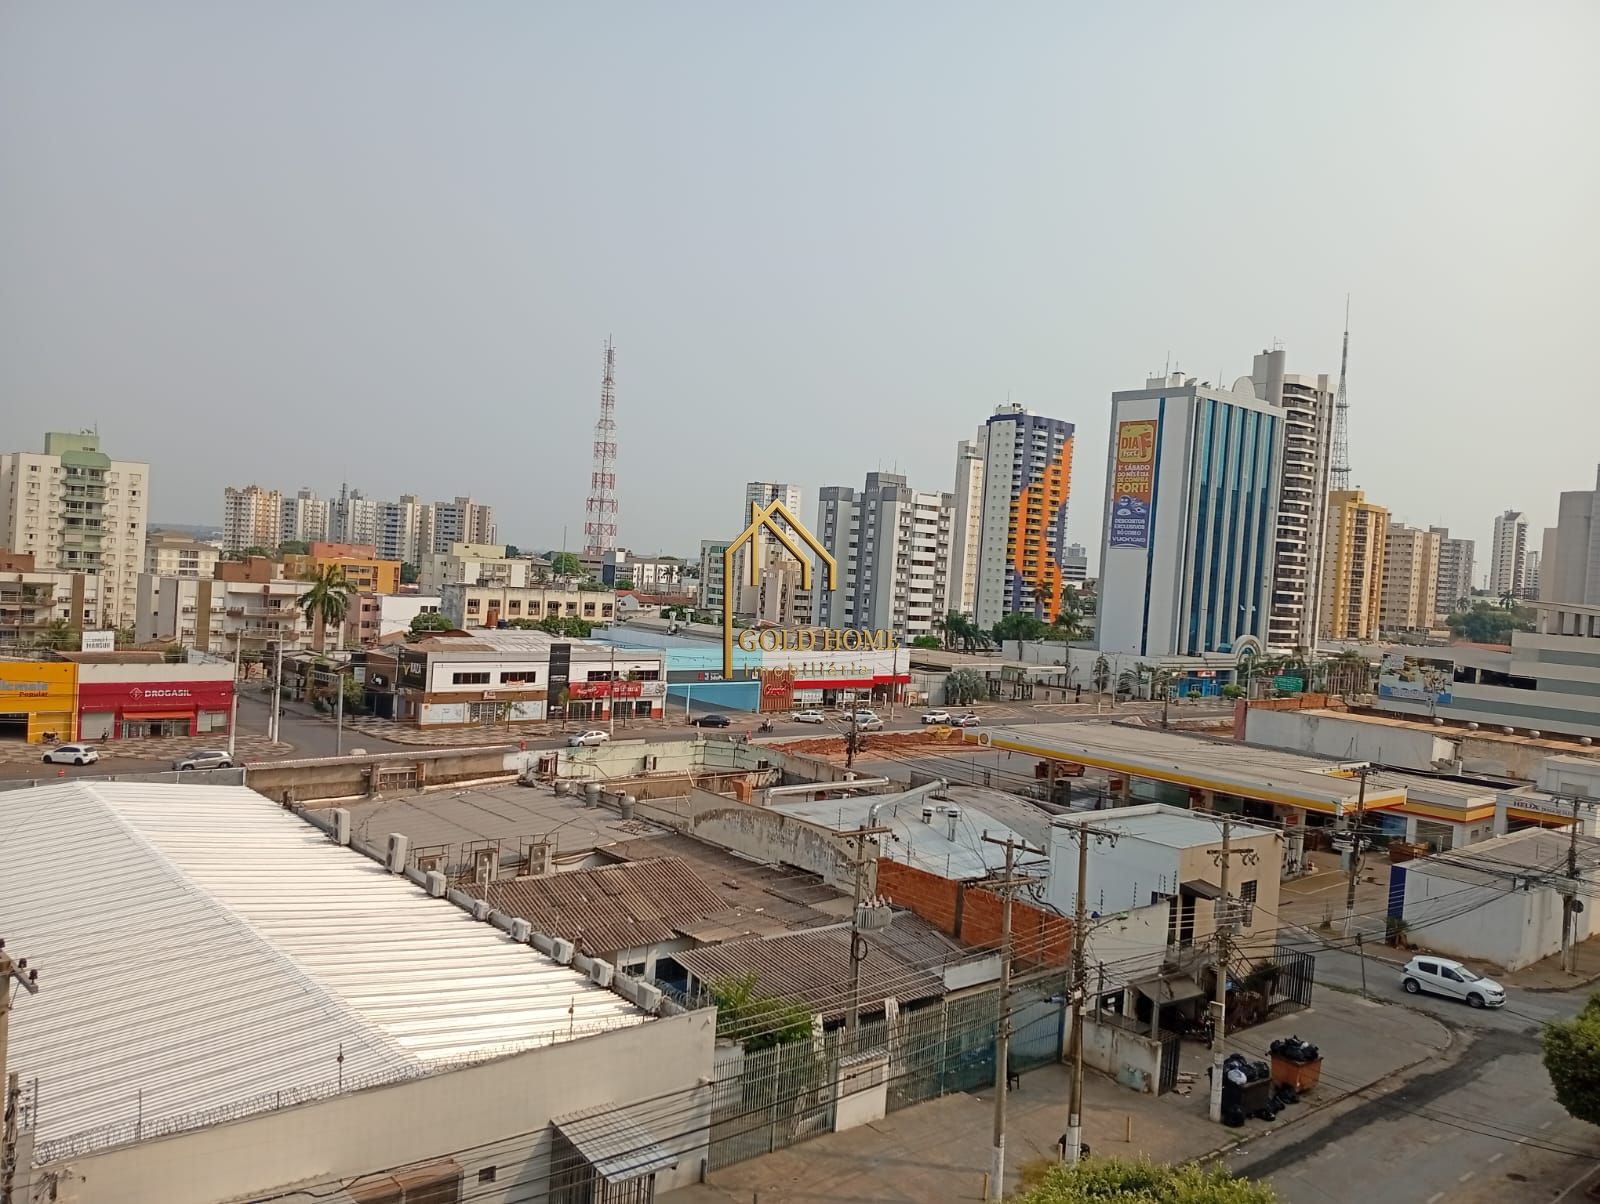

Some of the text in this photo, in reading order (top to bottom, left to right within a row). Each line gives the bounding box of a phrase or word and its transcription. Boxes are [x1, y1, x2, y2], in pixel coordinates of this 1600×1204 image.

[1121, 437, 1138, 449] DIA
[1116, 482, 1149, 493] FORT!
[144, 689, 192, 698] DROGASIL
